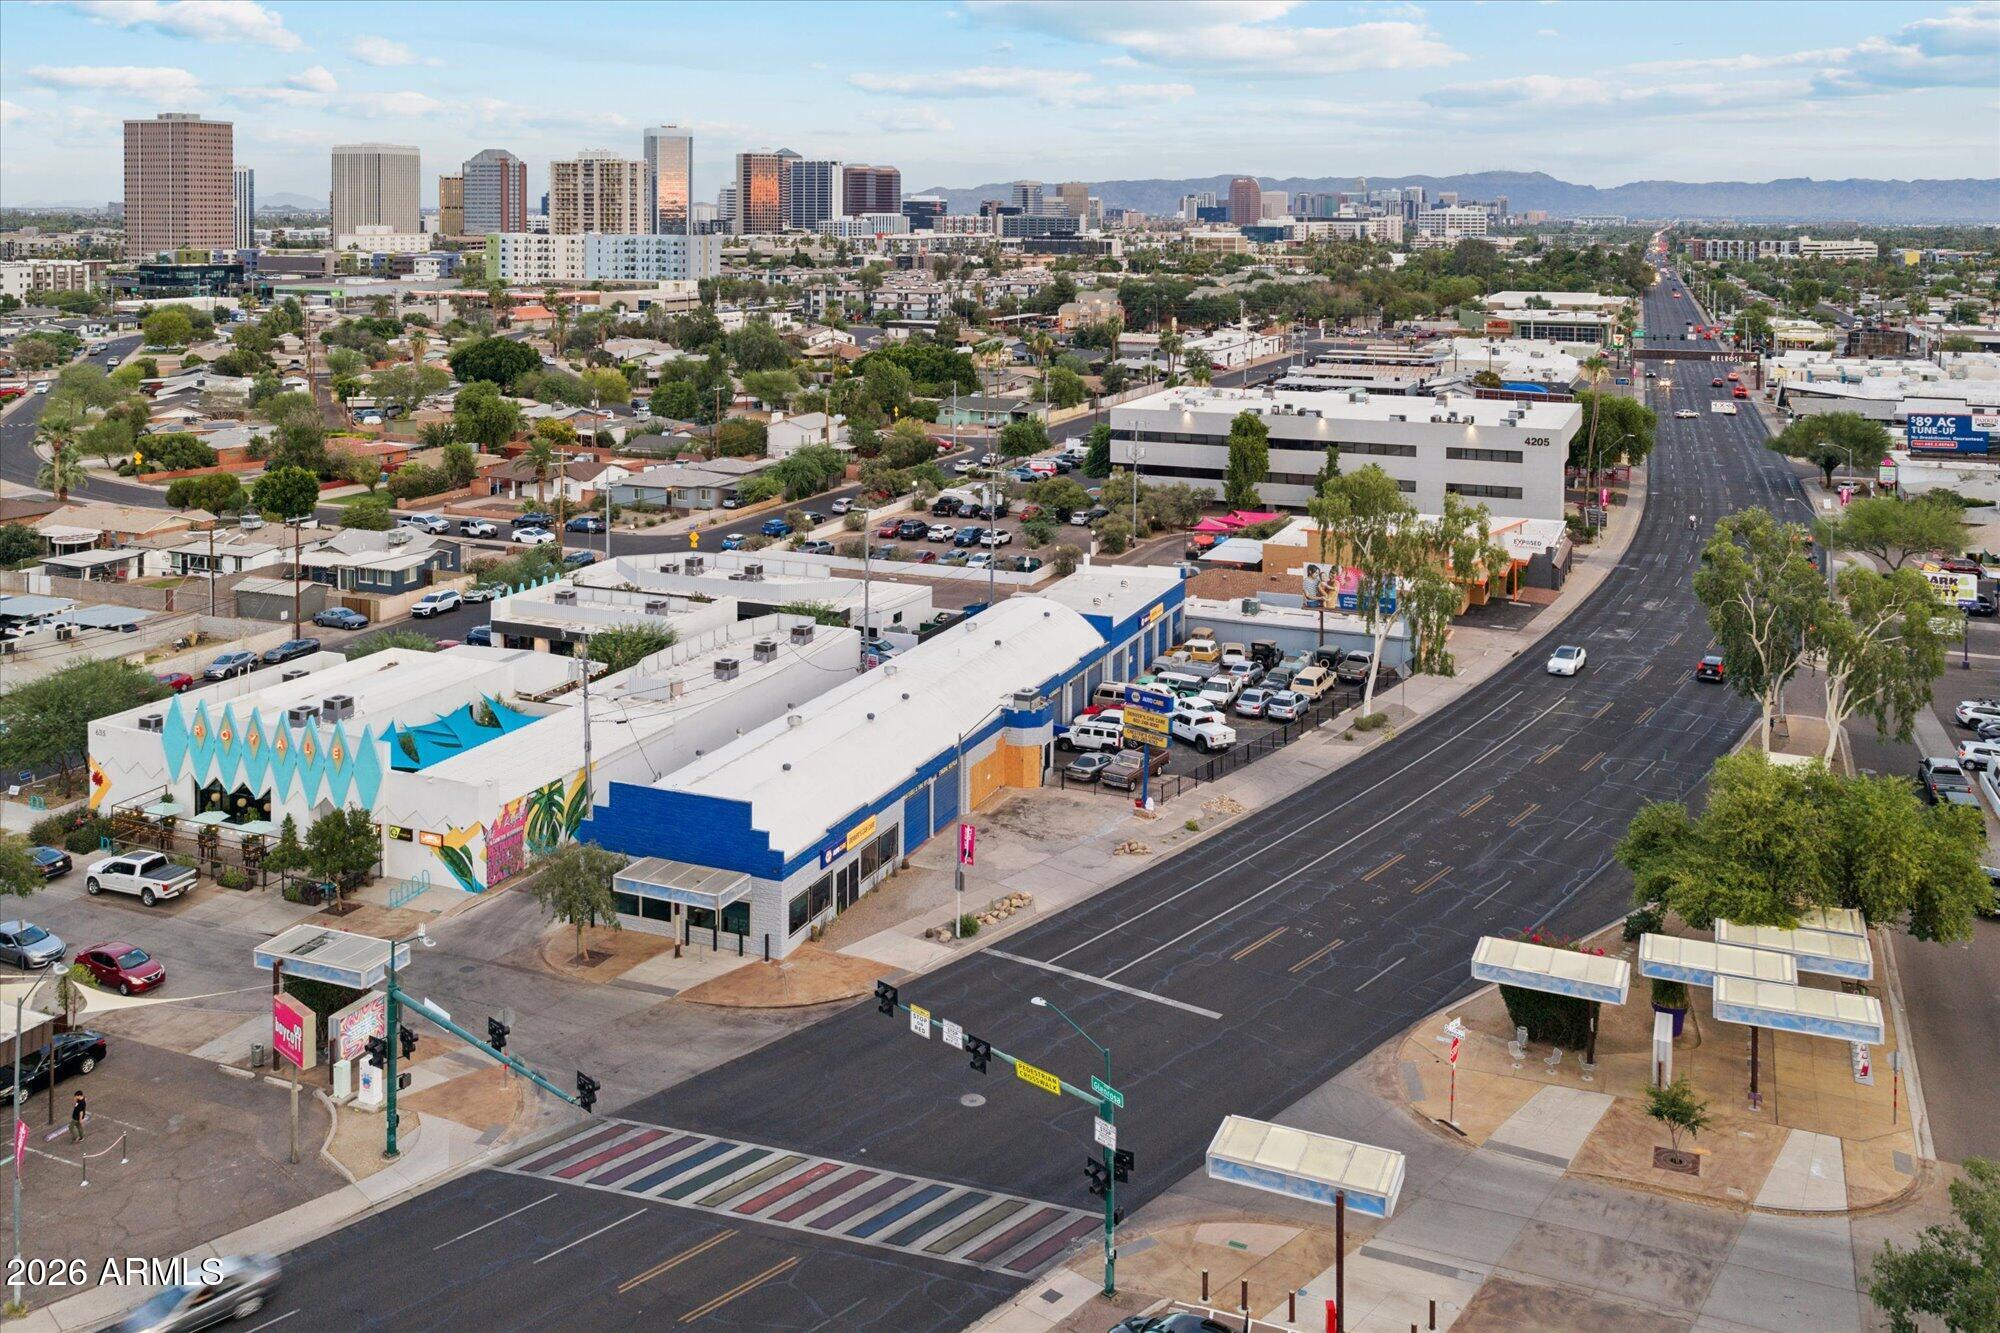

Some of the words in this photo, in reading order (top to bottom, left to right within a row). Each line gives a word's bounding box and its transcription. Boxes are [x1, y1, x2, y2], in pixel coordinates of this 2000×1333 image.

[1711, 355, 1743, 363] MELROSE
[1911, 416, 1932, 427] $89
[1937, 417, 1956, 427] AC
[1911, 427, 1956, 435] TUNE-UP
[1524, 437, 1550, 447] 4205
[1513, 538, 1542, 547] EXPOSED
[1930, 576, 1958, 585] ARK
[913, 1013, 928, 1023] STOP
[914, 1025, 926, 1035] RED
[1018, 1063, 1058, 1086] PEDESTRIAN
[1019, 1071, 1058, 1093] CROSSWALK
[1093, 1081, 1121, 1104] Glenrosa
